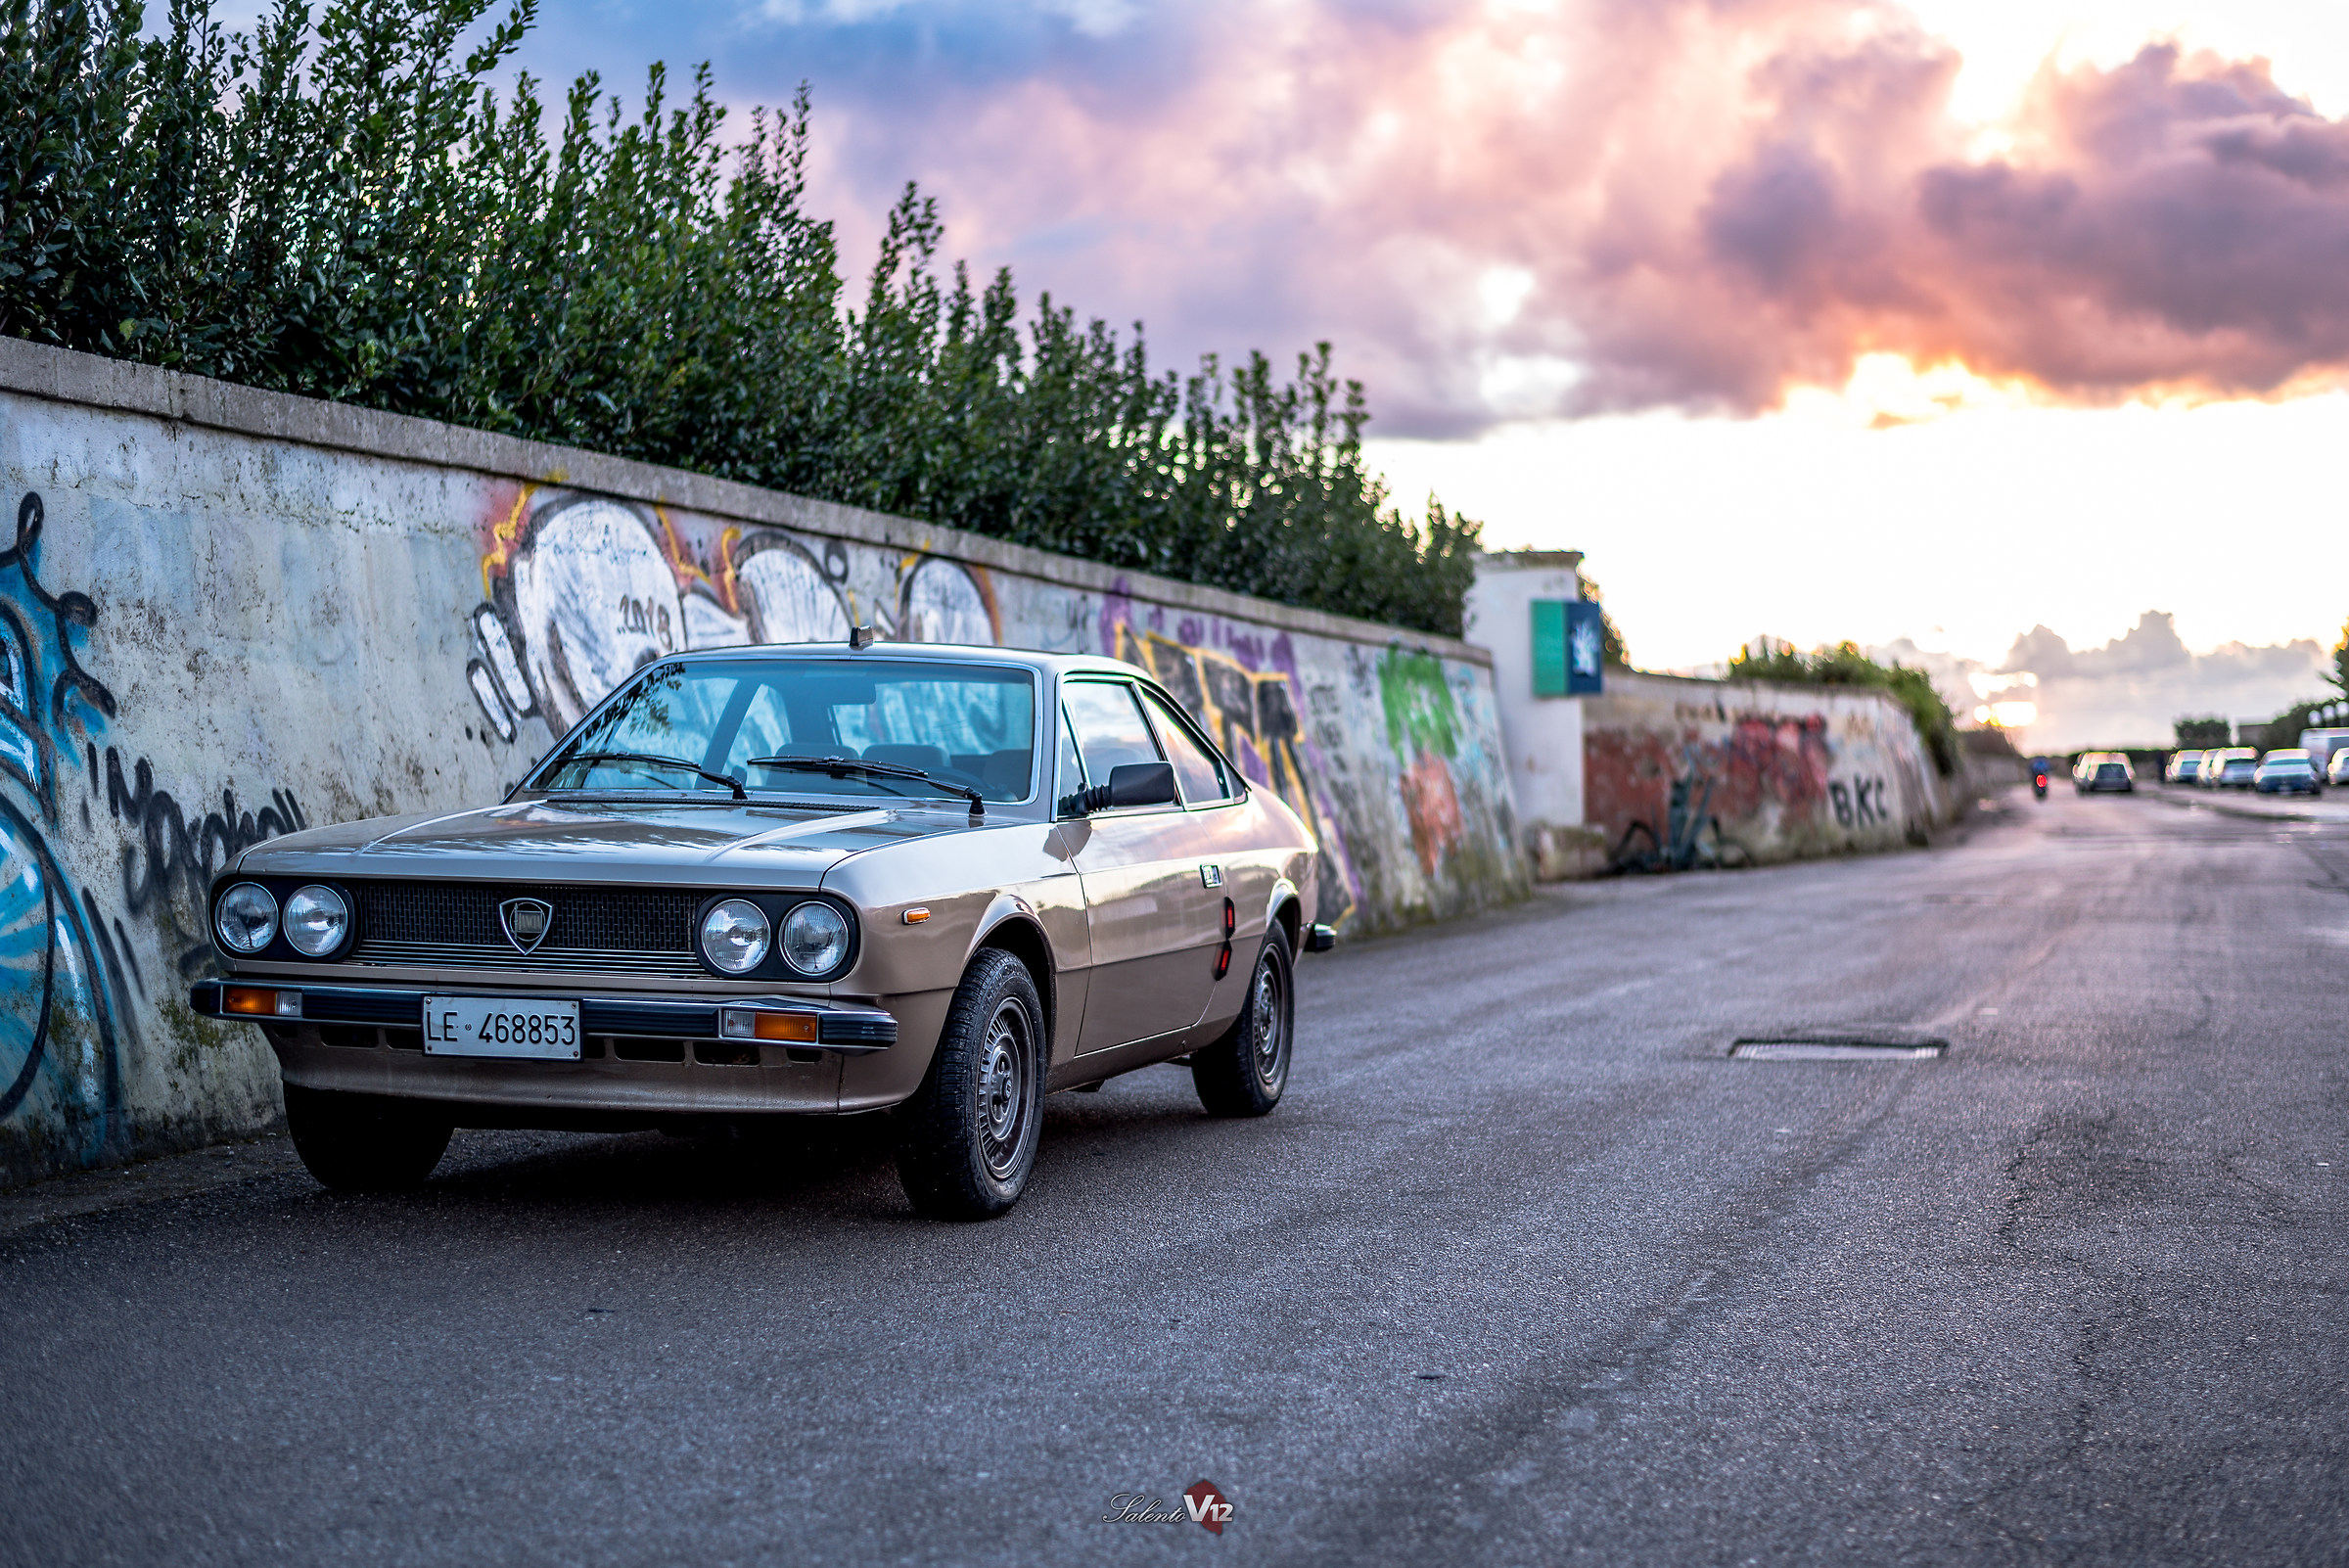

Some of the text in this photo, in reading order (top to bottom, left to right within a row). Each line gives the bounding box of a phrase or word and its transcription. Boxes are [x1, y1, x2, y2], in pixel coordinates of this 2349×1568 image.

[1828, 772, 1887, 829] BKC
[427, 1011, 576, 1045] LE 468853
